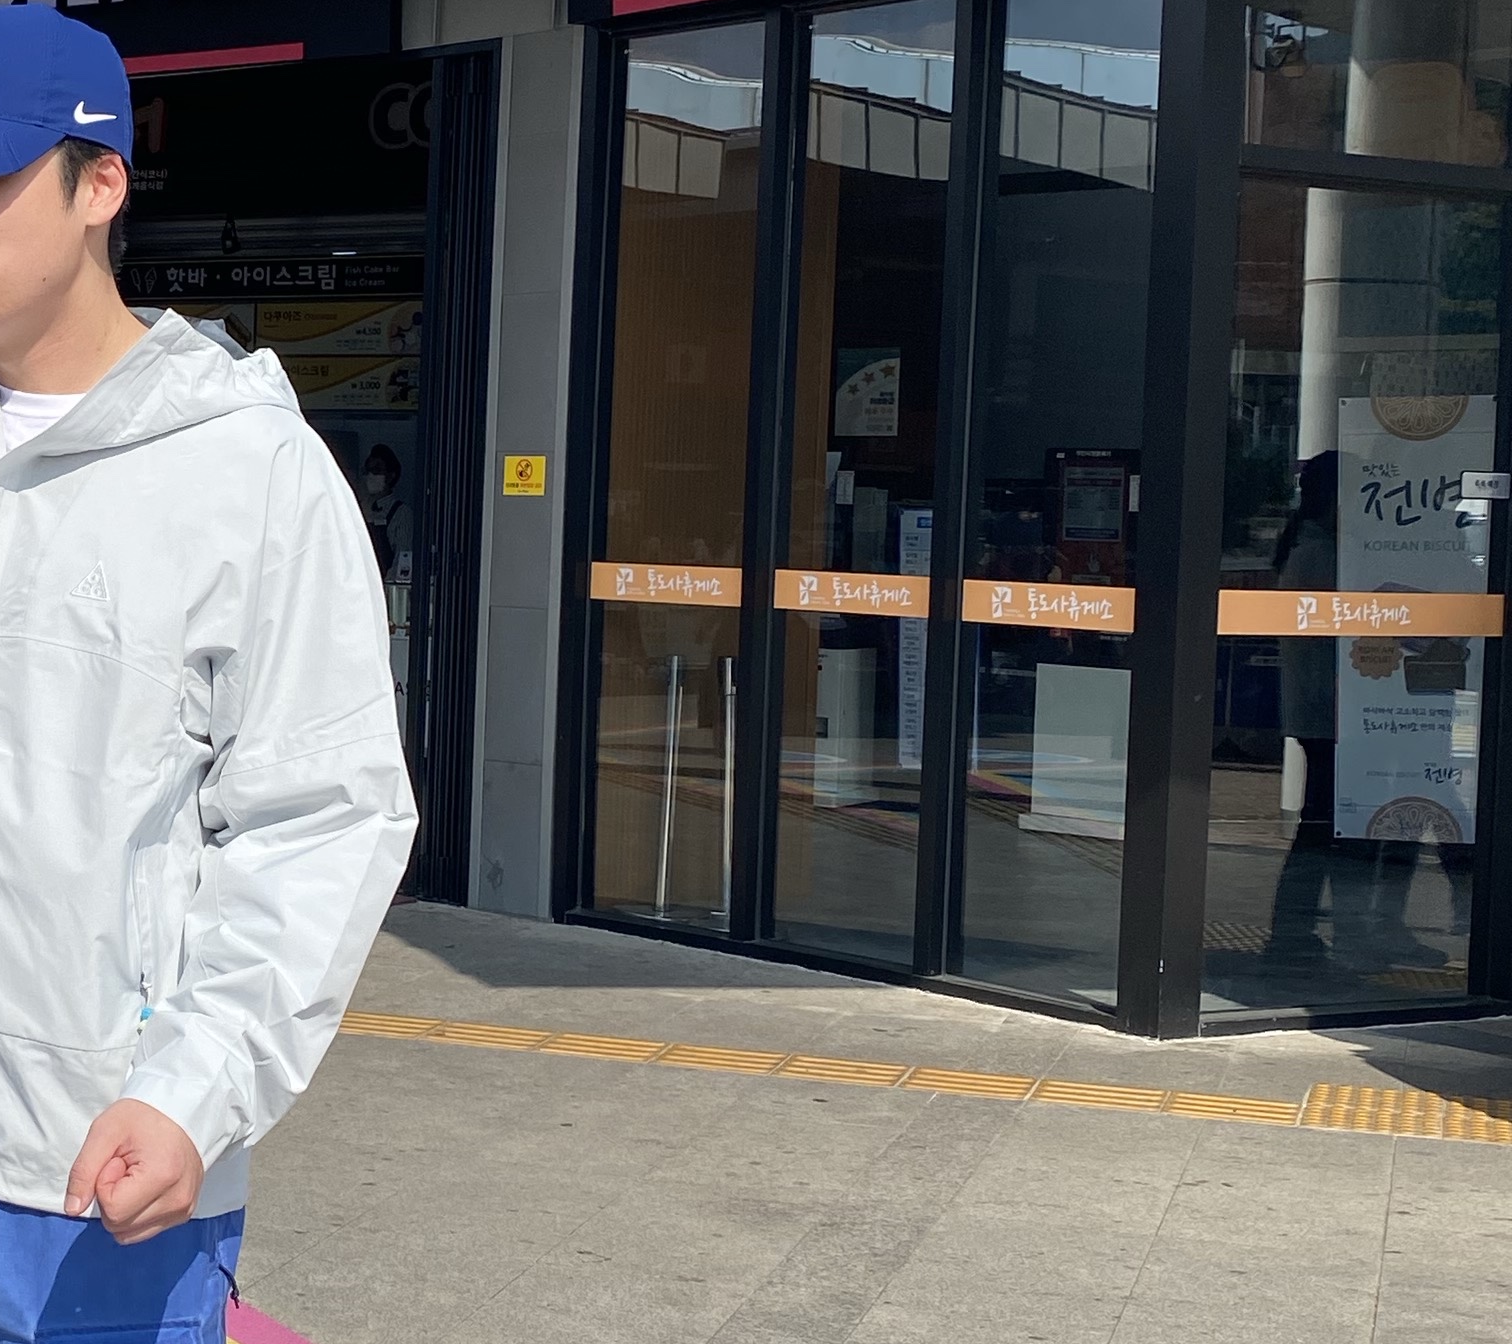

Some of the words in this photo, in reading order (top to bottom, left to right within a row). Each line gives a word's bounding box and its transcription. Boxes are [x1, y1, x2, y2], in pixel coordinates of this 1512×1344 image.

[166, 265, 207, 293] 핫바
[231, 263, 337, 291] 아이스크림
[1362, 463, 1400, 478] 맛있는
[1363, 540, 1420, 552] KOREAN
[1424, 540, 1471, 552] BISCUIT
[648, 568, 723, 598] 통도사휴게소
[832, 576, 913, 609] 통도사휴게소
[1028, 587, 1114, 622] 통도사휴게소
[1332, 596, 1412, 630] 통도사휴게소
[1363, 718, 1419, 734] 통도사휴게소
